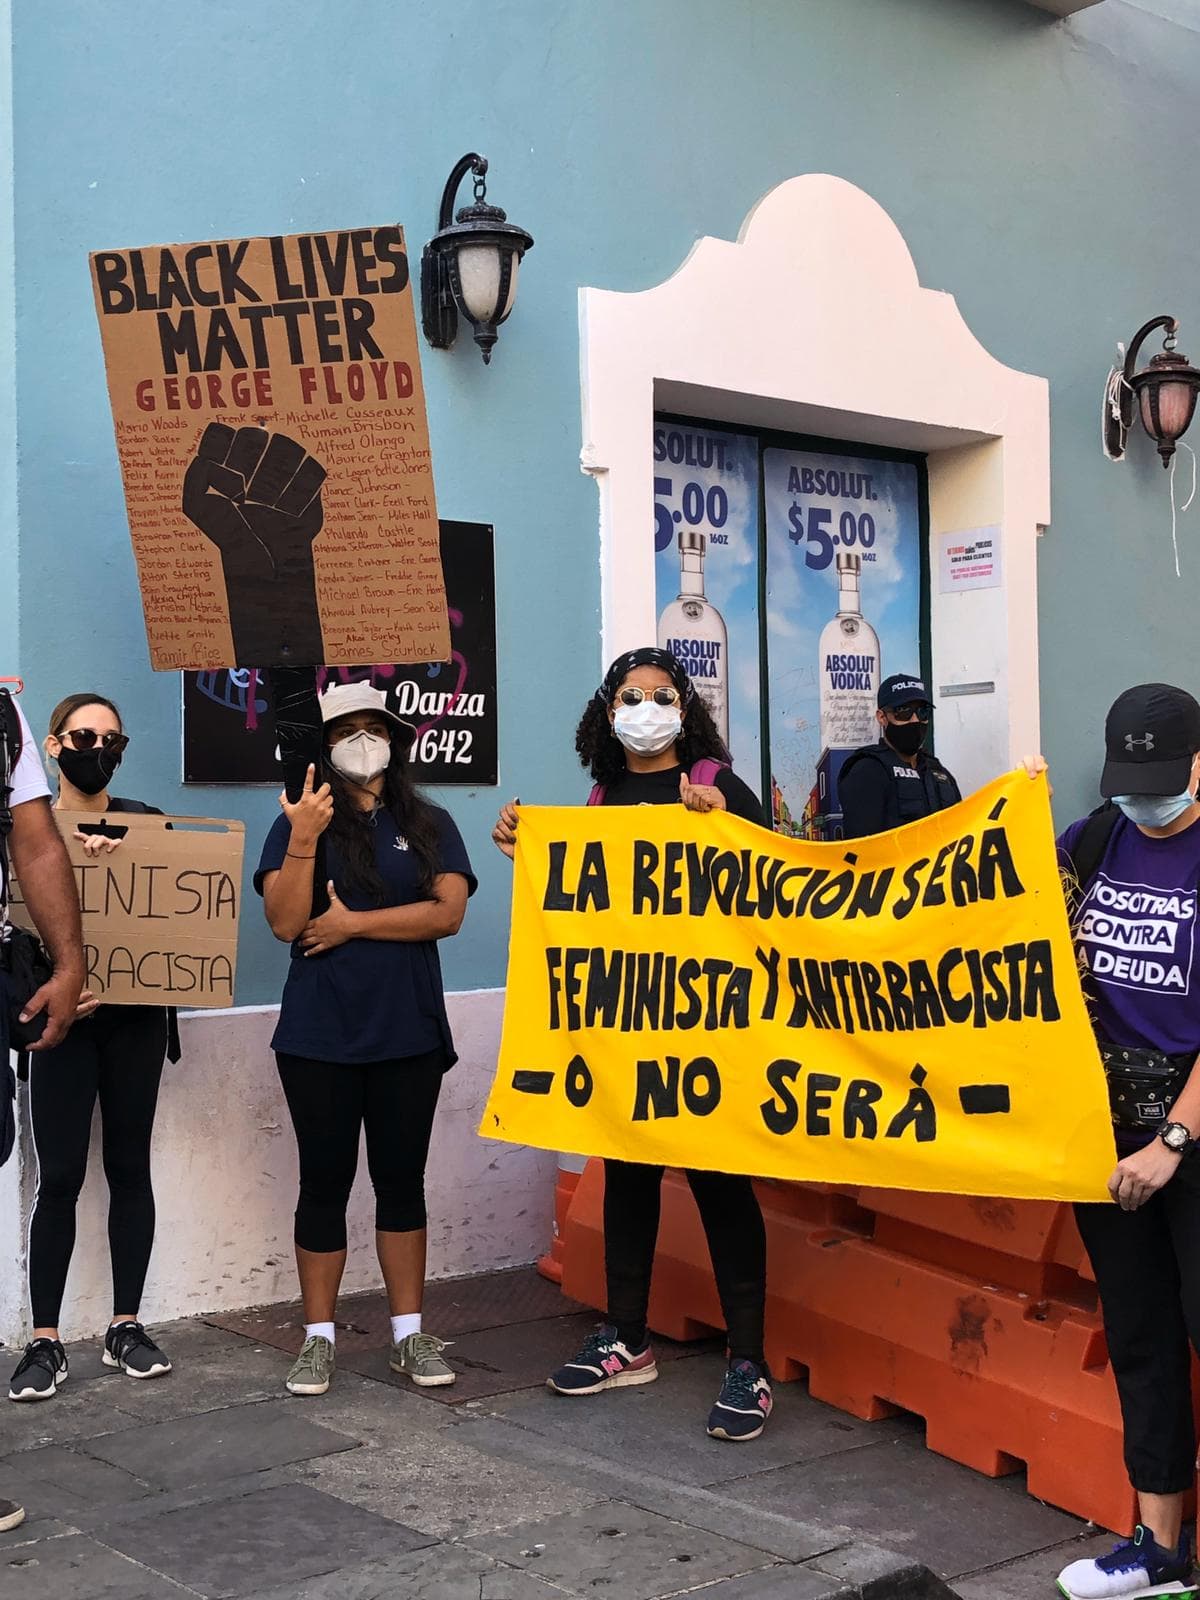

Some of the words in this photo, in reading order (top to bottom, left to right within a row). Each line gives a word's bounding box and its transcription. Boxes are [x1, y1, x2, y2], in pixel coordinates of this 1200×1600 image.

[94, 240, 263, 314] BLACK
[270, 227, 410, 301] LIVES
[156, 298, 385, 375] MATTER
[136, 371, 274, 412] GEORGE
[299, 361, 414, 405] FLOYD
[116, 420, 149, 434] Mario
[151, 415, 189, 430] Woods
[286, 407, 339, 425] Michelle
[346, 406, 416, 418] Cusseaux
[297, 424, 352, 438] Rumain
[352, 417, 416, 433] Brisbon
[315, 438, 355, 454] Alfred
[360, 433, 406, 450] Olango
[654, 428, 734, 472] SOLUT.
[326, 452, 375, 465] Maurice
[380, 446, 430, 461] Granton
[124, 469, 148, 480] Felix
[400, 461, 430, 474] Jones
[357, 478, 402, 494] Johnson
[407, 495, 429, 506] Ford
[412, 509, 431, 520] Hall
[654, 476, 729, 553] 5.00
[378, 522, 415, 538] Castile
[788, 500, 876, 571] $5.00
[180, 542, 207, 552] Clark
[417, 536, 438, 547] Scott
[137, 557, 172, 569] Jordan
[175, 556, 214, 569] Edwards
[141, 571, 168, 582] Alton
[172, 569, 212, 582] Sterling
[318, 586, 360, 601] Michael
[362, 585, 396, 598] Brown
[403, 601, 426, 613] Sean
[426, 600, 445, 613] Bell
[417, 621, 441, 632] Scott
[150, 646, 188, 665] Tamir
[193, 641, 221, 660] Rice
[327, 642, 375, 659] James
[381, 639, 438, 658] Scurlock
[666, 638, 721, 660] ABSOLUT
[679, 658, 718, 679] ODKA
[825, 654, 875, 673] ABSOLUT
[830, 672, 873, 691] VODKA
[394, 679, 486, 717] Danza
[408, 729, 474, 765] 1642
[543, 840, 610, 914] LA
[632, 838, 896, 921] REVOLUCIÓN
[890, 797, 1026, 921] SERÁ
[1080, 913, 1173, 947] CONTRA
[1092, 949, 1186, 989] DEUDA
[546, 946, 754, 1033] FEMINISTA
[755, 945, 781, 1021] Y
[787, 938, 1061, 1035] ANTIRRACISTA
[631, 1055, 722, 1122] NO
[759, 1062, 938, 1144] SERÁ
